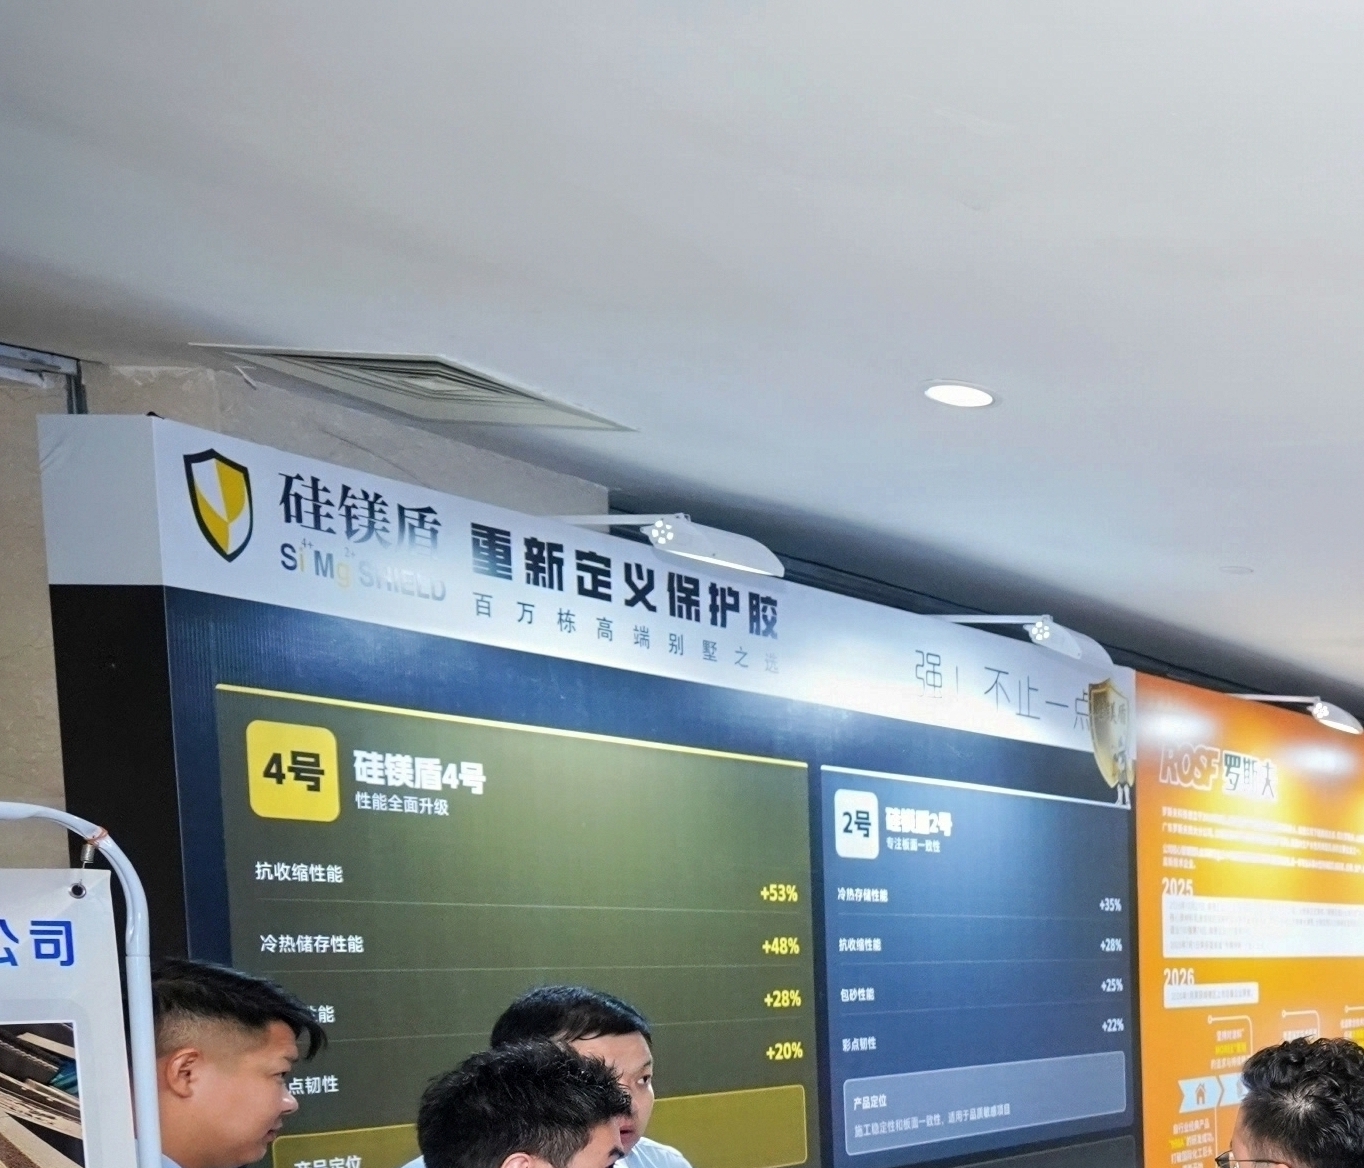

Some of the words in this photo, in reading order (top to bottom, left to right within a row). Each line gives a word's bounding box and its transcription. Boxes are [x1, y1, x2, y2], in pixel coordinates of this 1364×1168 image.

[278, 472, 441, 559] 硅镁盾
[359, 561, 446, 604] SHIELD
[470, 522, 779, 640] 重新定义保护胶
[473, 591, 780, 674] 百万栋高端别墅之选
[262, 752, 325, 793] 4号
[353, 750, 487, 795] 硅镁盾4号
[1159, 742, 1220, 792] ROSF
[1222, 751, 1278, 800] 罗斯夫
[355, 791, 450, 817] 性能全面升级
[843, 810, 872, 838] 2号
[886, 837, 940, 853] 专注板面一致性
[255, 861, 344, 884] 抗收缩性能
[760, 884, 798, 903] +53%
[1162, 878, 1194, 896] 2025
[1099, 898, 1122, 912] +35%
[259, 934, 364, 954] 冷热储存性能
[762, 937, 800, 956] +48%
[839, 938, 881, 952] 抗收缩性能
[1100, 938, 1123, 952] +28%
[1101, 978, 1123, 993] +25%
[1163, 967, 1195, 986] 2026
[764, 989, 802, 1009] +28%
[1102, 1018, 1124, 1033] +22%
[766, 1042, 804, 1061] +20%
[853, 1094, 887, 1110] 产品定位
